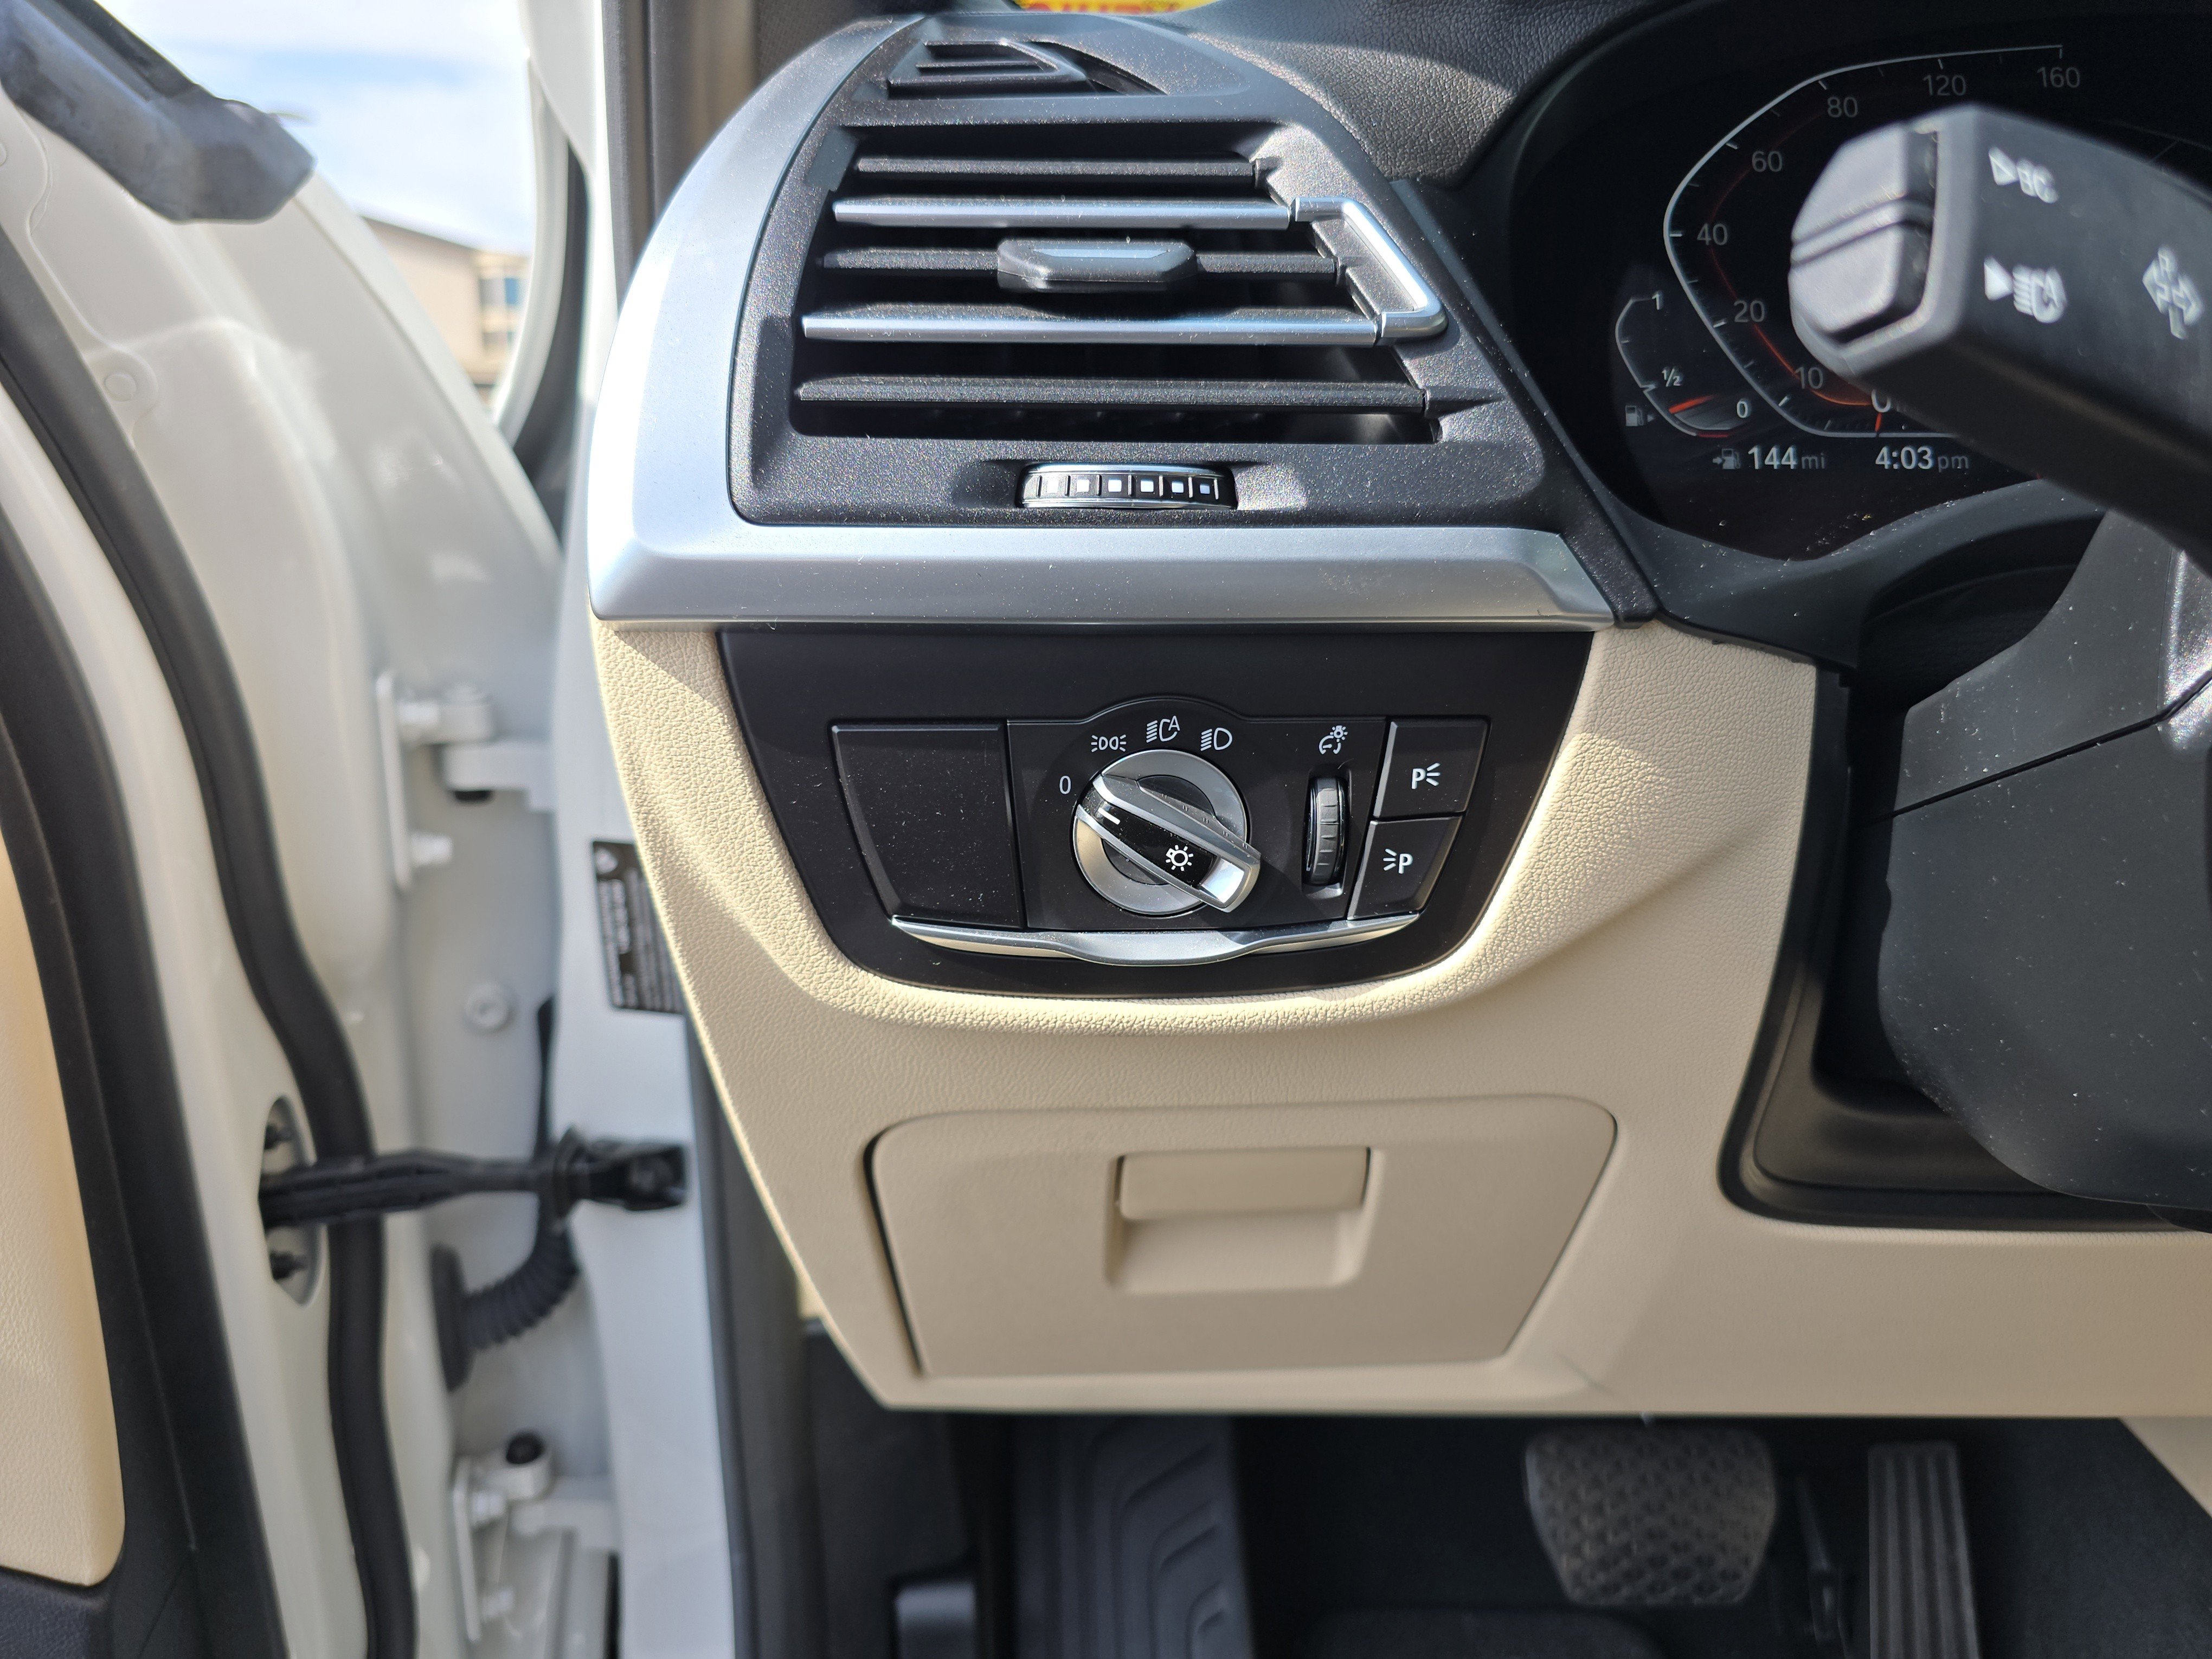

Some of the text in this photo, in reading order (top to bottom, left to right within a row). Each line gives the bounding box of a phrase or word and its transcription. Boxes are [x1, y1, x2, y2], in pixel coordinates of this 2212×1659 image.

[1922, 74, 1967, 97] 120
[2037, 66, 2081, 88] 160
[1827, 97, 1859, 118] 80
[1751, 150, 1783, 172] 60
[1696, 223, 1728, 246] 40
[1652, 291, 1663, 310] 1
[1733, 300, 1765, 323] 20
[1795, 366, 1824, 389] 10
[1737, 400, 1750, 419] 0
[1747, 444, 1826, 471] 144 mi
[1875, 445, 1969, 473] 4:03 pm
[1059, 775, 1072, 795] 0
